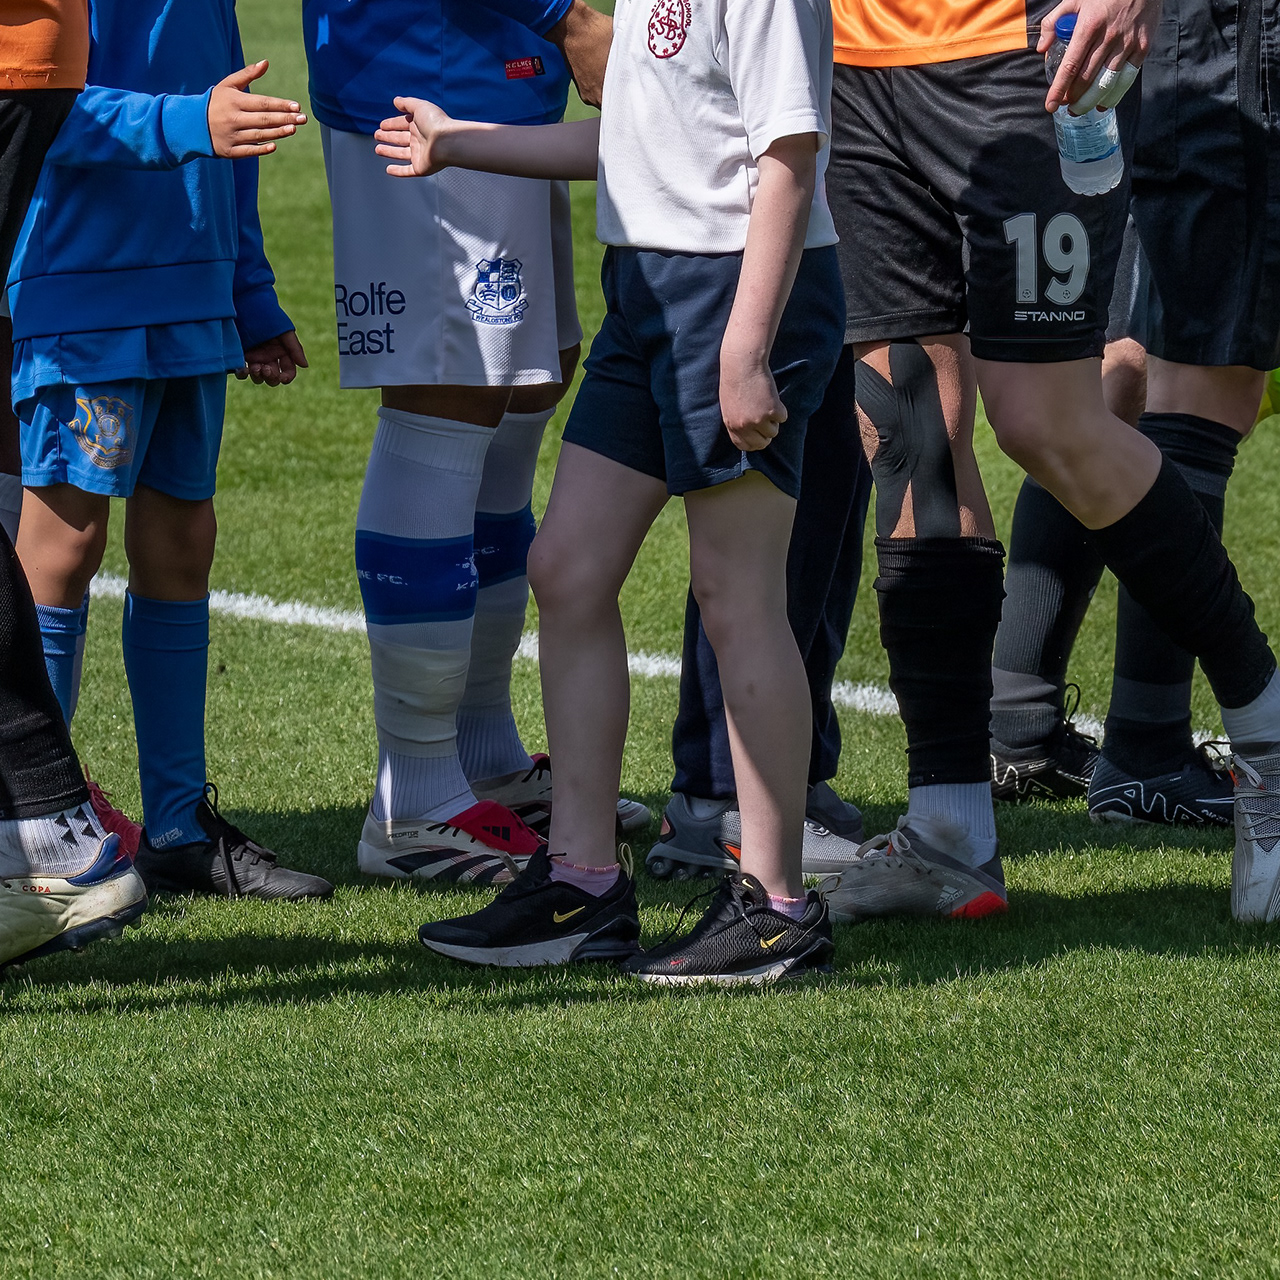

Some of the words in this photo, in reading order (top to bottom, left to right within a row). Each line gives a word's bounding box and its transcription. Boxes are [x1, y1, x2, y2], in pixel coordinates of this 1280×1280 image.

[1003, 212, 1091, 306] 19
[335, 281, 406, 317] Rolfe
[1014, 310, 1086, 322] STANNO
[337, 322, 395, 356] East
[22, 884, 51, 893] COPA
